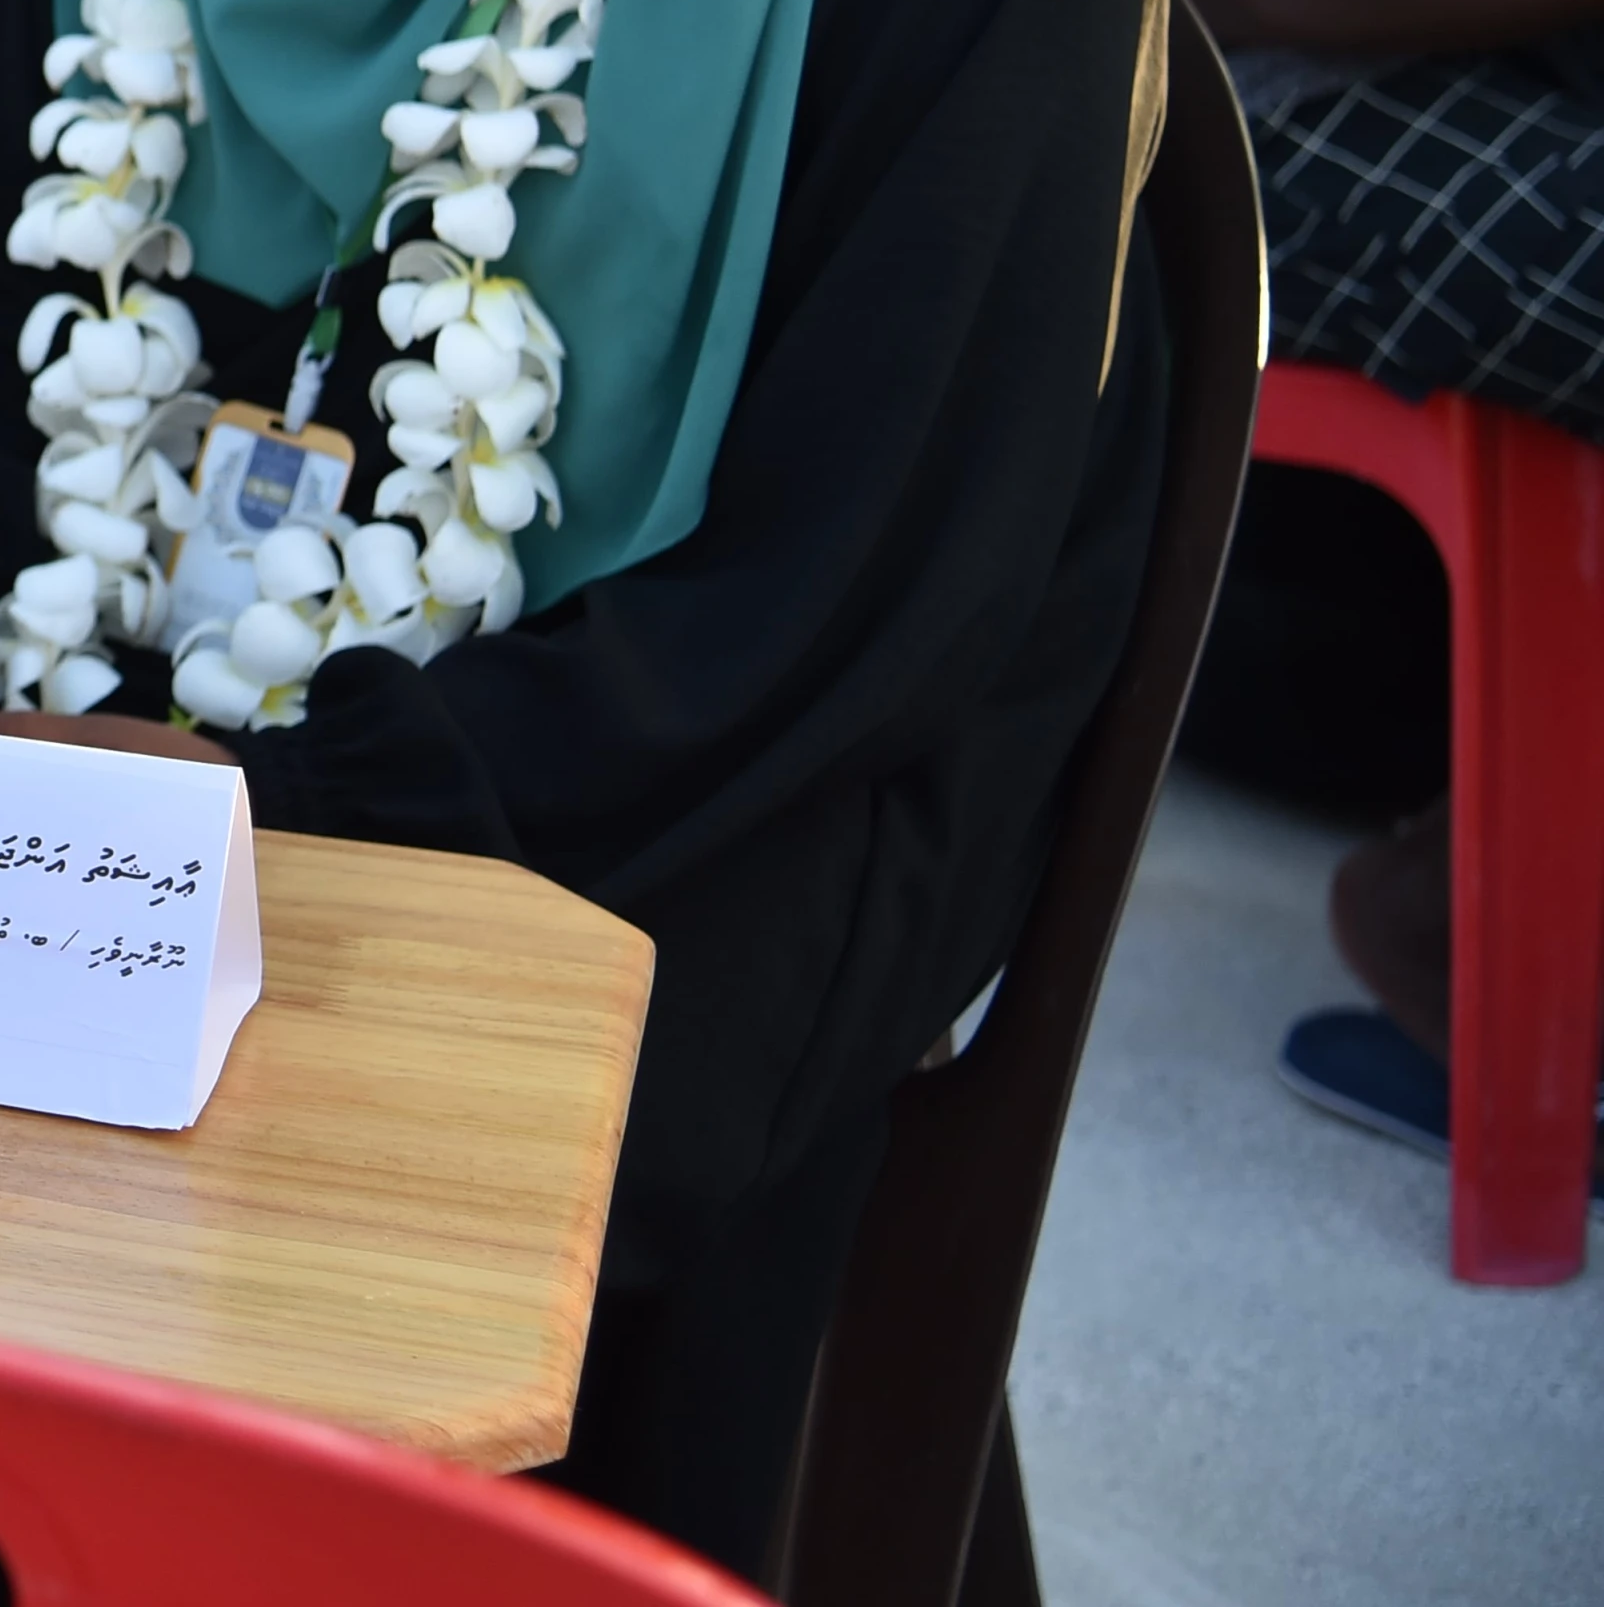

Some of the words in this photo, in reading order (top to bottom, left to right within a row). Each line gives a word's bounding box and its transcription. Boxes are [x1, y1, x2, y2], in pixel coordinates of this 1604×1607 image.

[81, 847, 202, 907] ޢާއިޝަތު
[59, 929, 80, 951] /
[88, 936, 186, 978] ނޫރާނީވެހި
